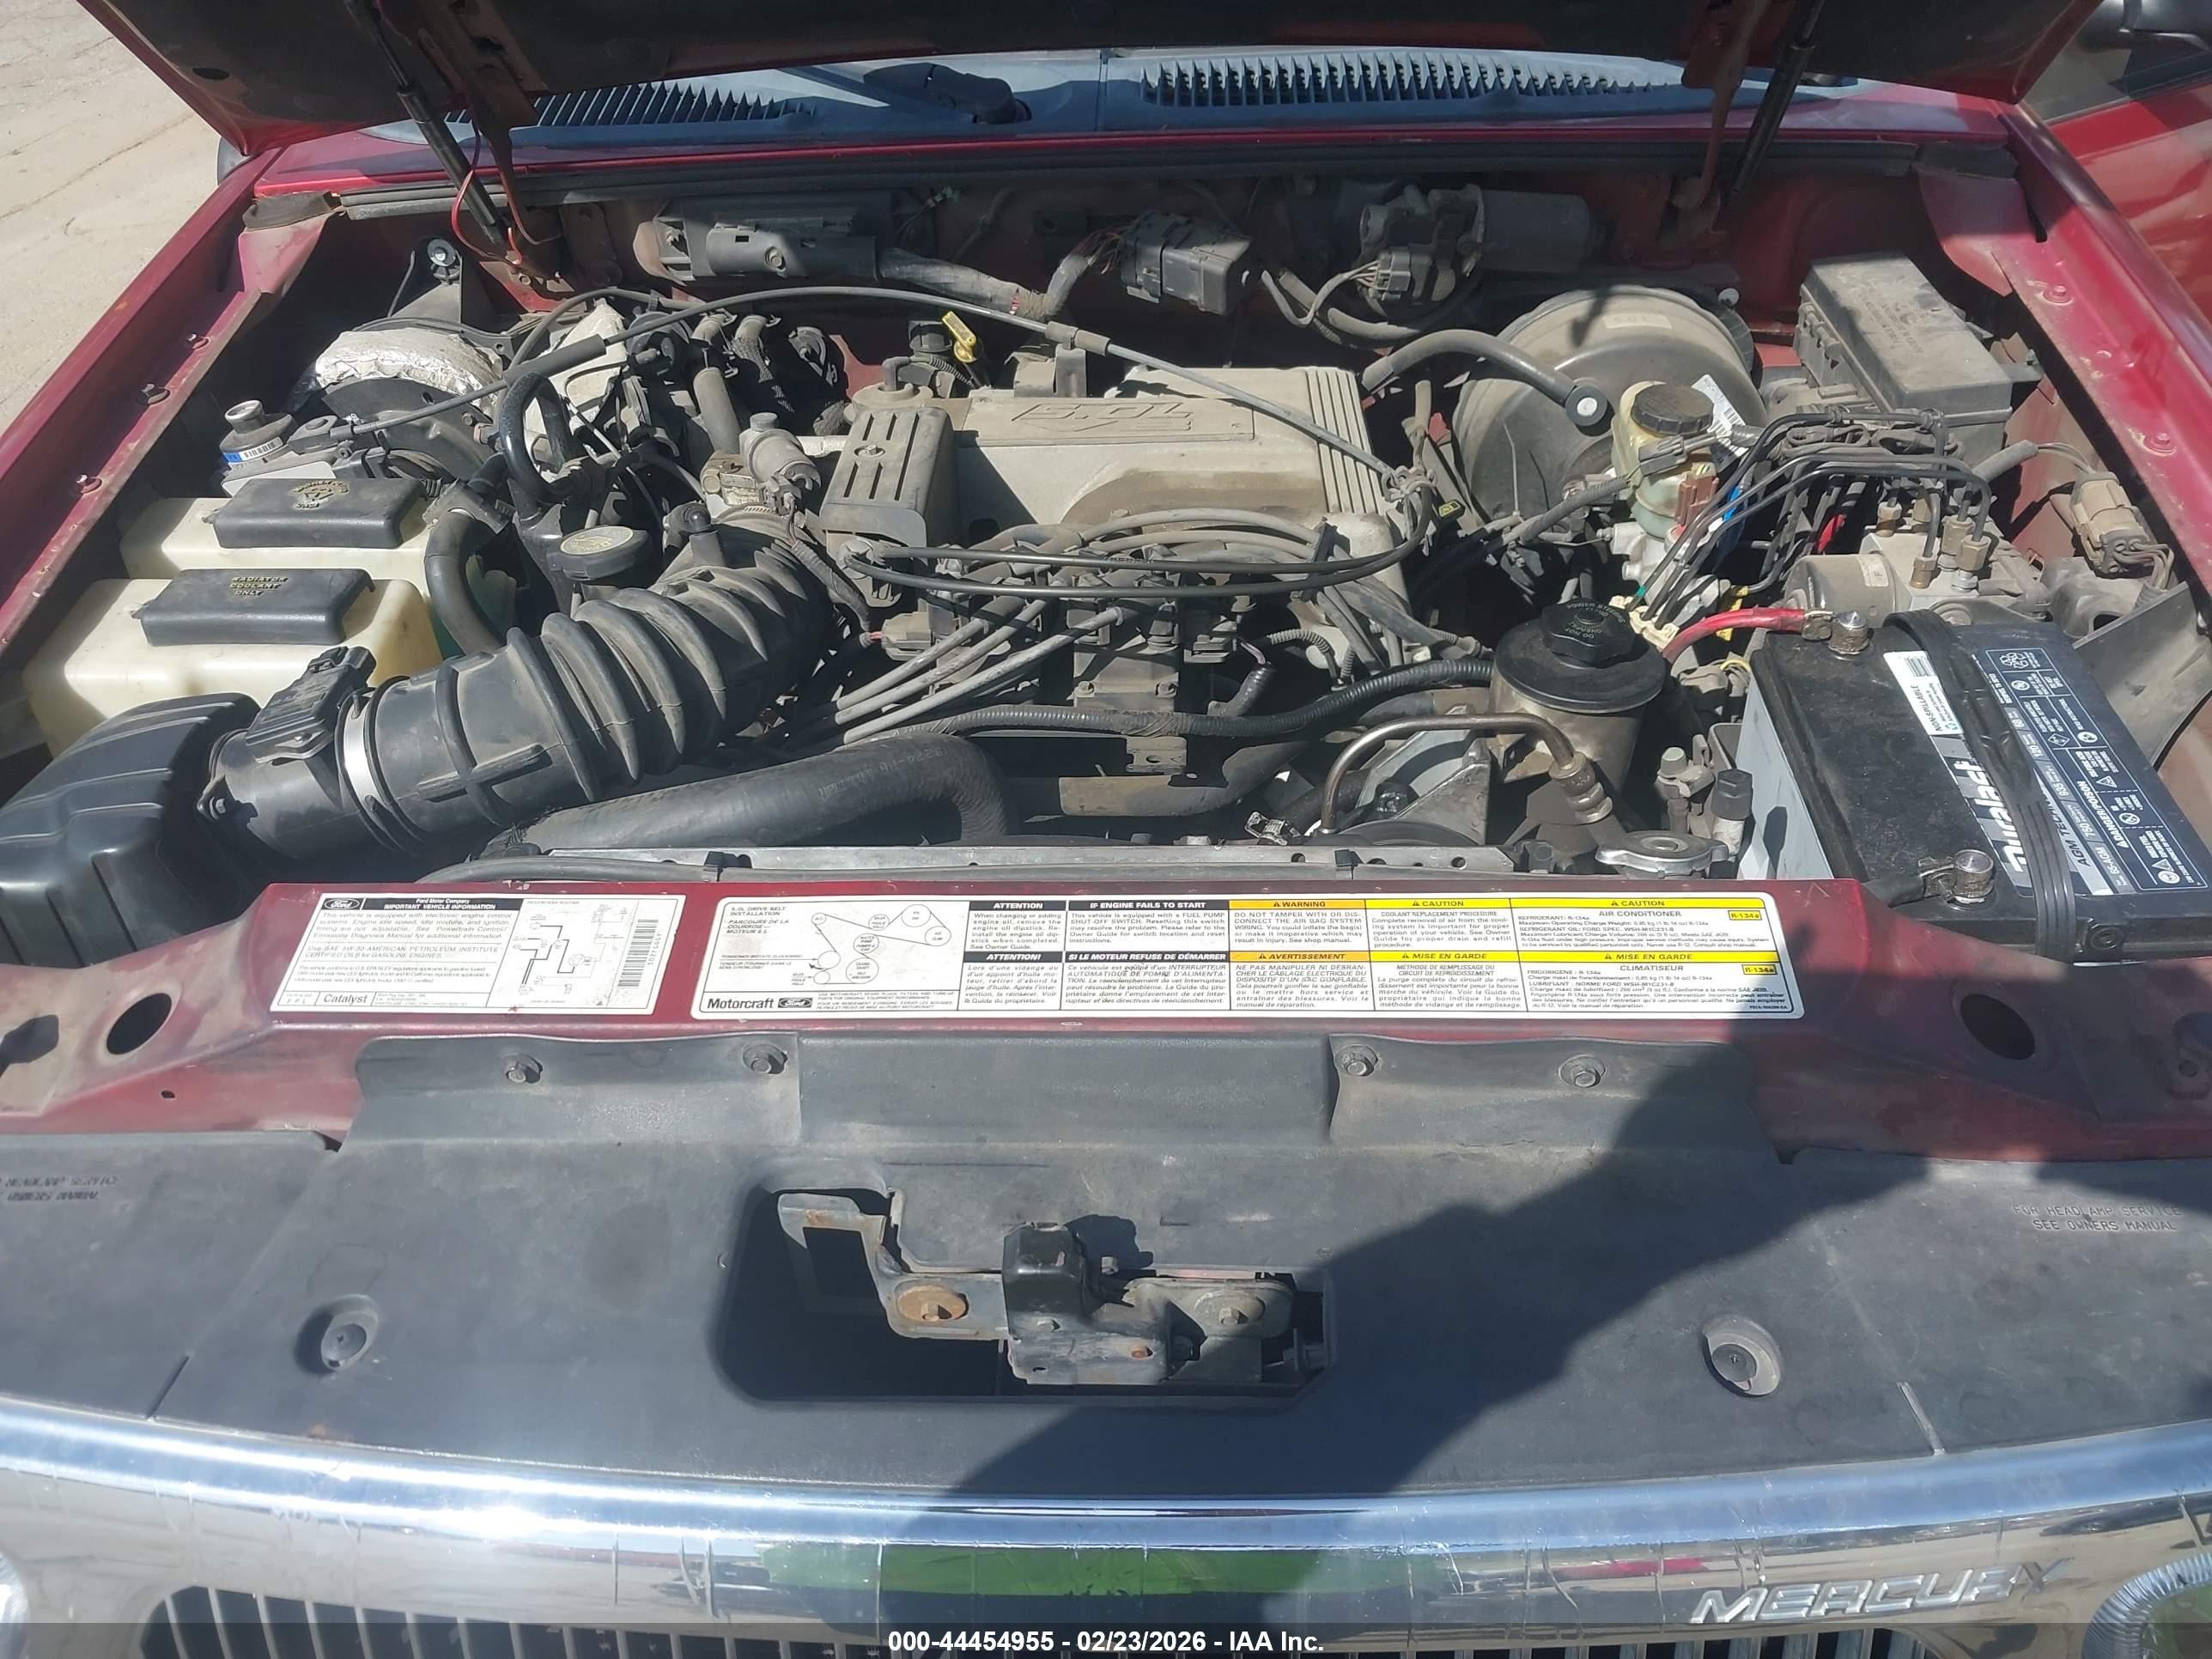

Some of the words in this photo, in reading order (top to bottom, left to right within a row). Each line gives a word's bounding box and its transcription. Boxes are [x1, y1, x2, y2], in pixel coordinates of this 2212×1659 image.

[1911, 685, 1942, 732] NON-SPILLABLE
[2077, 781, 2124, 842] DANGER/POISON
[2080, 823, 2095, 837] 750
[2065, 840, 2090, 866] AGM
[323, 994, 368, 1004] Catalyst
[707, 998, 775, 1009] Motorcraft
[2013, 1205, 2039, 1216] FOR
[2046, 1206, 2112, 1216] HEADLAMP
[2123, 1206, 2182, 1216] SERVICE
[2033, 1220, 2060, 1230] SEE
[2067, 1221, 2119, 1231] OWNERS
[2126, 1221, 2178, 1231] MANUAL
[1690, 1557, 2075, 1624] MERCURY
